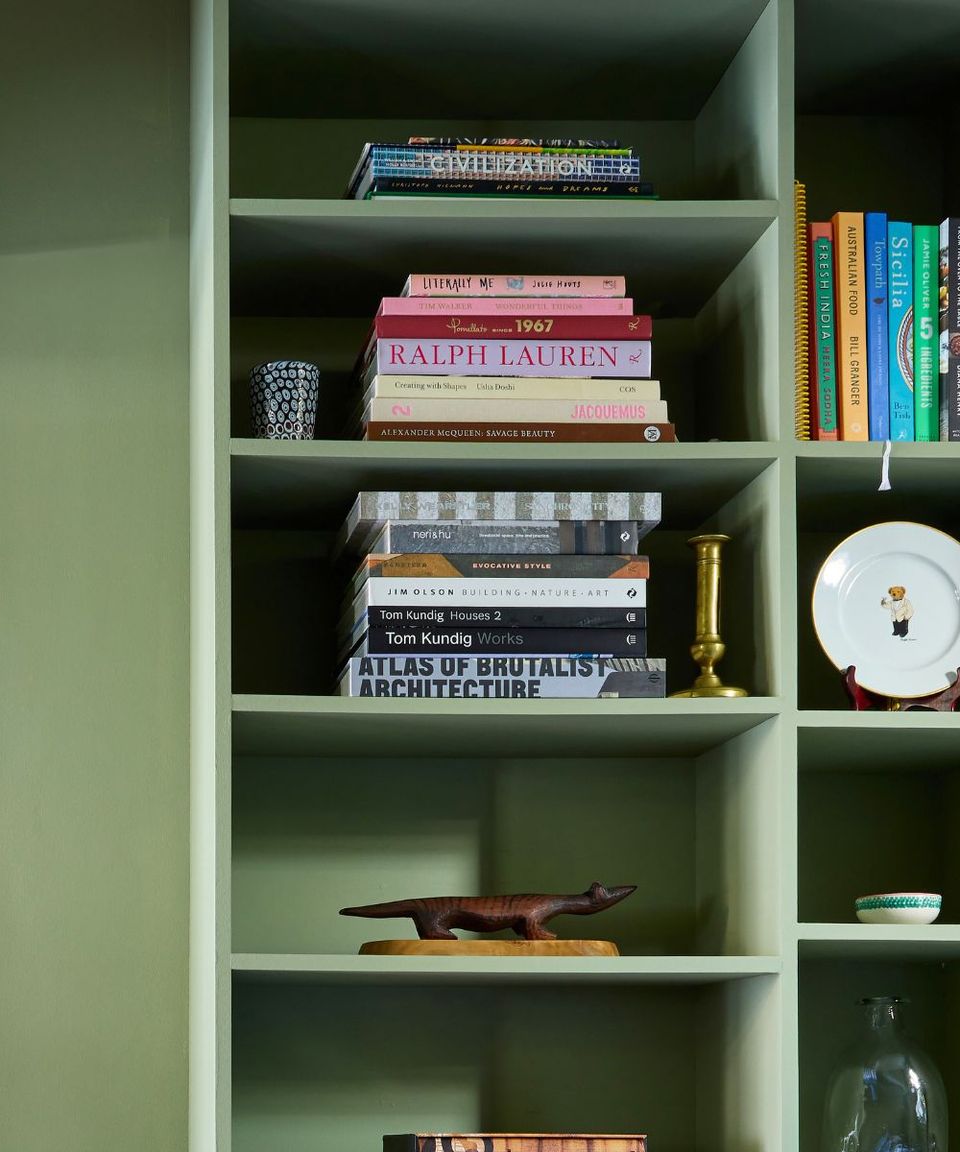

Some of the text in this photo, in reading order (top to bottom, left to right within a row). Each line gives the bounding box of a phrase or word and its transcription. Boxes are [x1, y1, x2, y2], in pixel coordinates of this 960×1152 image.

[431, 156, 592, 176] CIVILIZATION
[818, 244, 829, 289] FRESH
[872, 238, 886, 288] Towpath
[891, 236, 908, 308] Sicilia
[423, 277, 472, 292] LITERALLY
[479, 277, 495, 288] ME
[820, 296, 831, 340] INDIA
[848, 226, 860, 406] AUSTRALIAN FOOD BILL GRANGER
[515, 319, 554, 333] 1967
[920, 317, 933, 340] 5
[389, 344, 488, 366] RALPH
[499, 345, 619, 367] LAUREN
[394, 381, 425, 390] Creating
[426, 381, 442, 390] with
[442, 382, 467, 392] Shapes
[495, 383, 516, 391] Doshi
[920, 346, 933, 409] INGREDIENTS
[571, 404, 646, 420] JACQUEMUS
[381, 429, 435, 437] ALEXANDER
[520, 430, 556, 438] BEAUTY
[413, 529, 451, 540] neri&hu
[387, 588, 409, 596] JIM
[413, 588, 455, 596] OLSON
[380, 609, 502, 622] Tom Kundig Houses 2
[385, 632, 524, 647] Tom Kundig Works
[358, 657, 609, 678] ATLAS OF BRUTALIST
[359, 679, 540, 698] ARCHITECTURE
